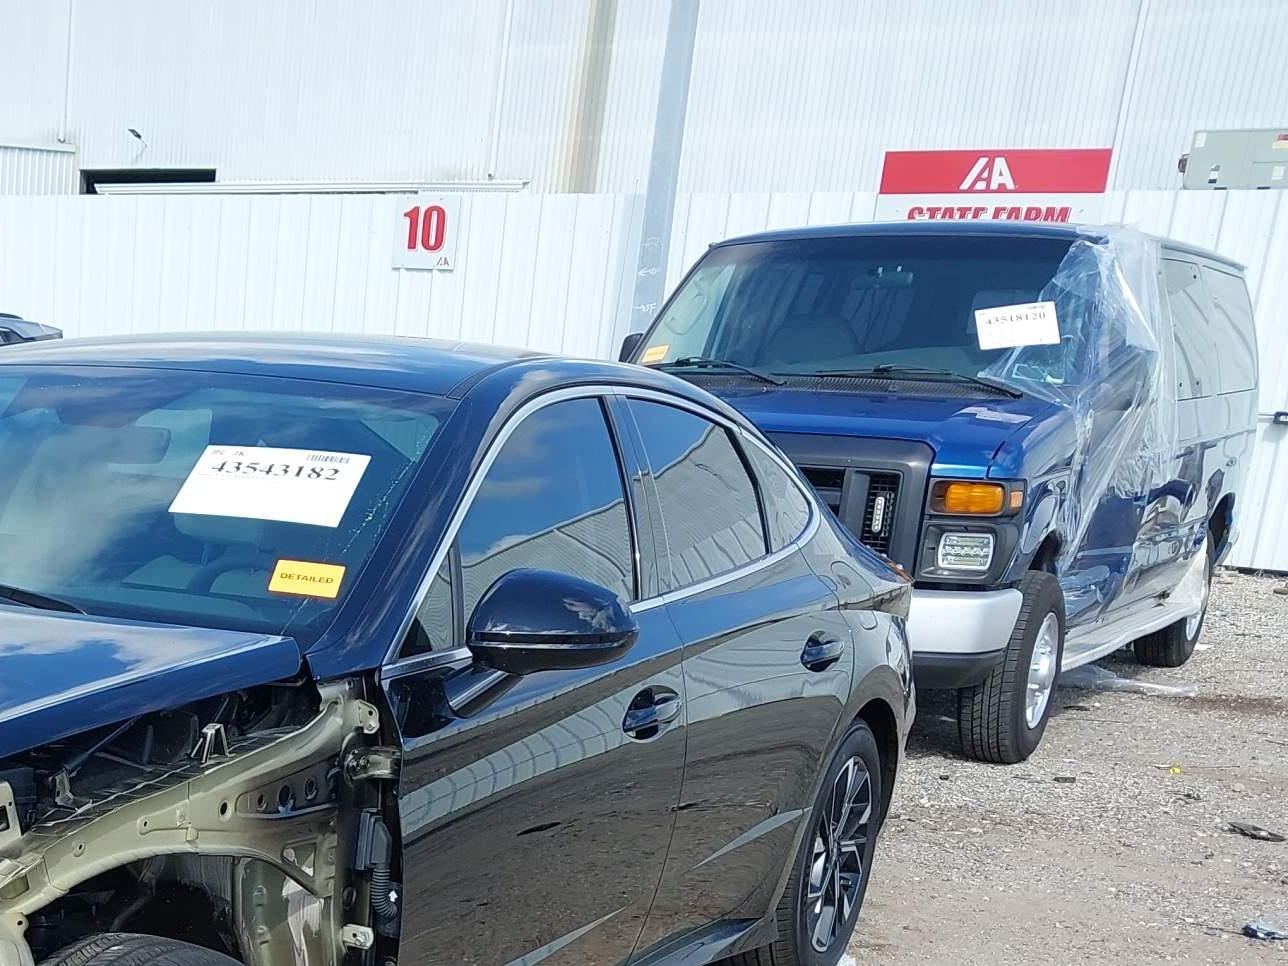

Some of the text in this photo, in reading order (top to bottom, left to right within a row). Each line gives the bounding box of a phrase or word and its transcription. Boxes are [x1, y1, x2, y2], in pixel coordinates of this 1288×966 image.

[403, 205, 447, 251] 10
[211, 460, 341, 481] 43543182
[279, 571, 334, 585] DETAILED
